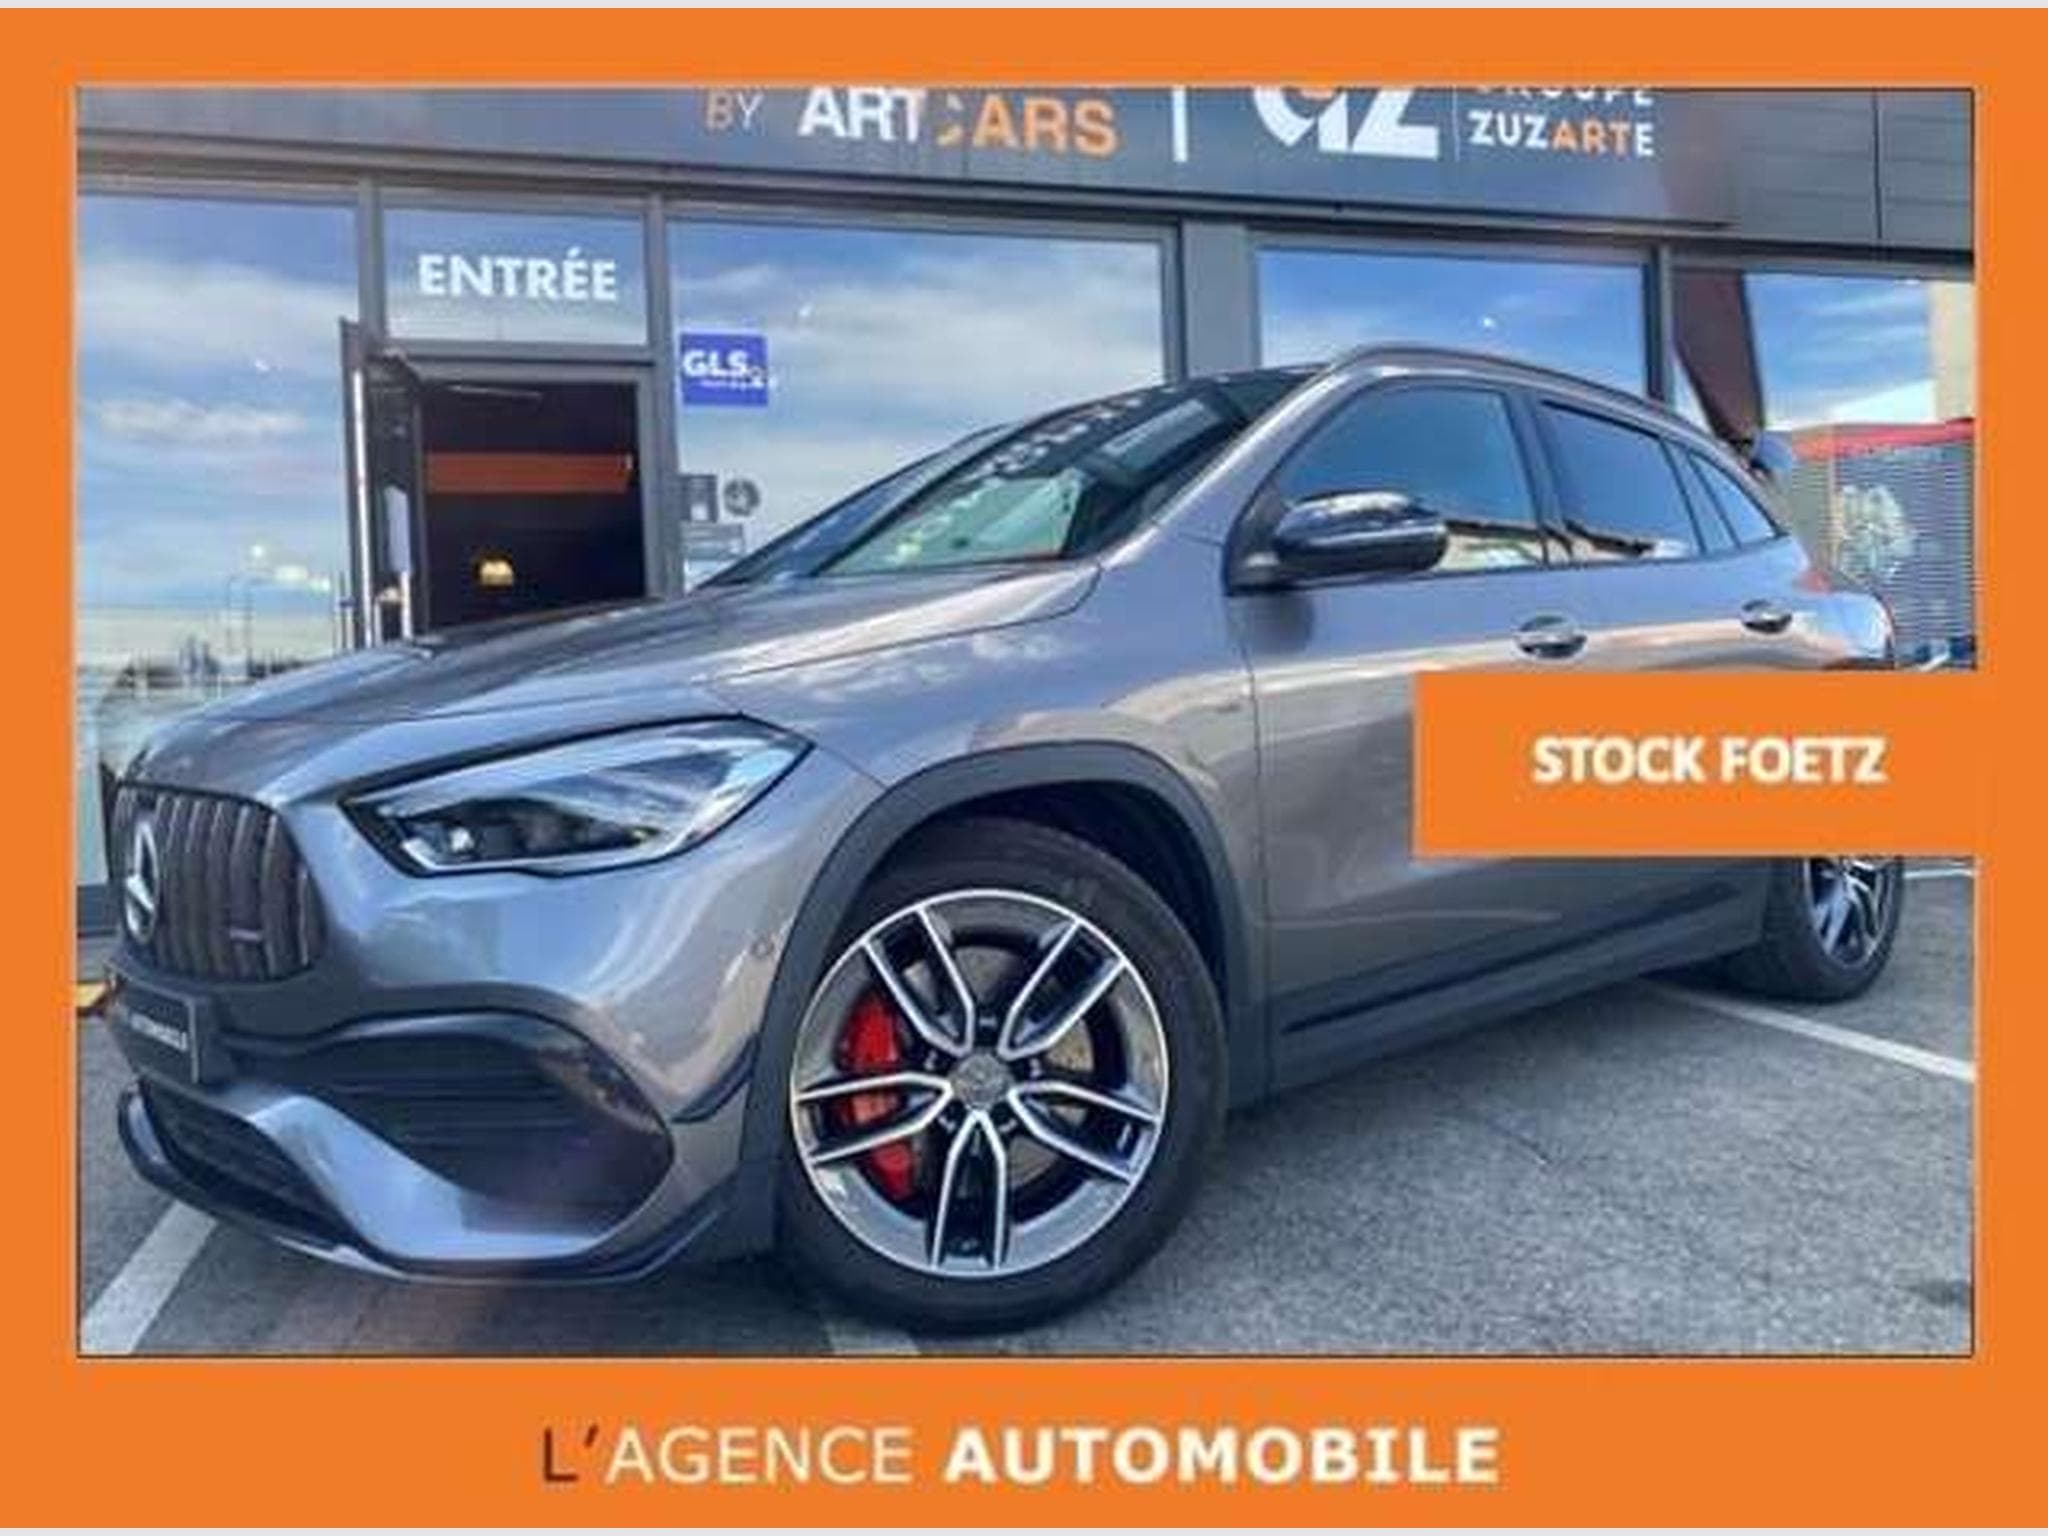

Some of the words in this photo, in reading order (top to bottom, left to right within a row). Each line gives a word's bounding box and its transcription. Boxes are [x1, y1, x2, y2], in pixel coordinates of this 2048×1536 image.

[704, 91, 764, 135] BY
[1467, 110, 1656, 159] ZUZARTE
[417, 247, 619, 301] ENTRÉE
[683, 349, 749, 378] GLS
